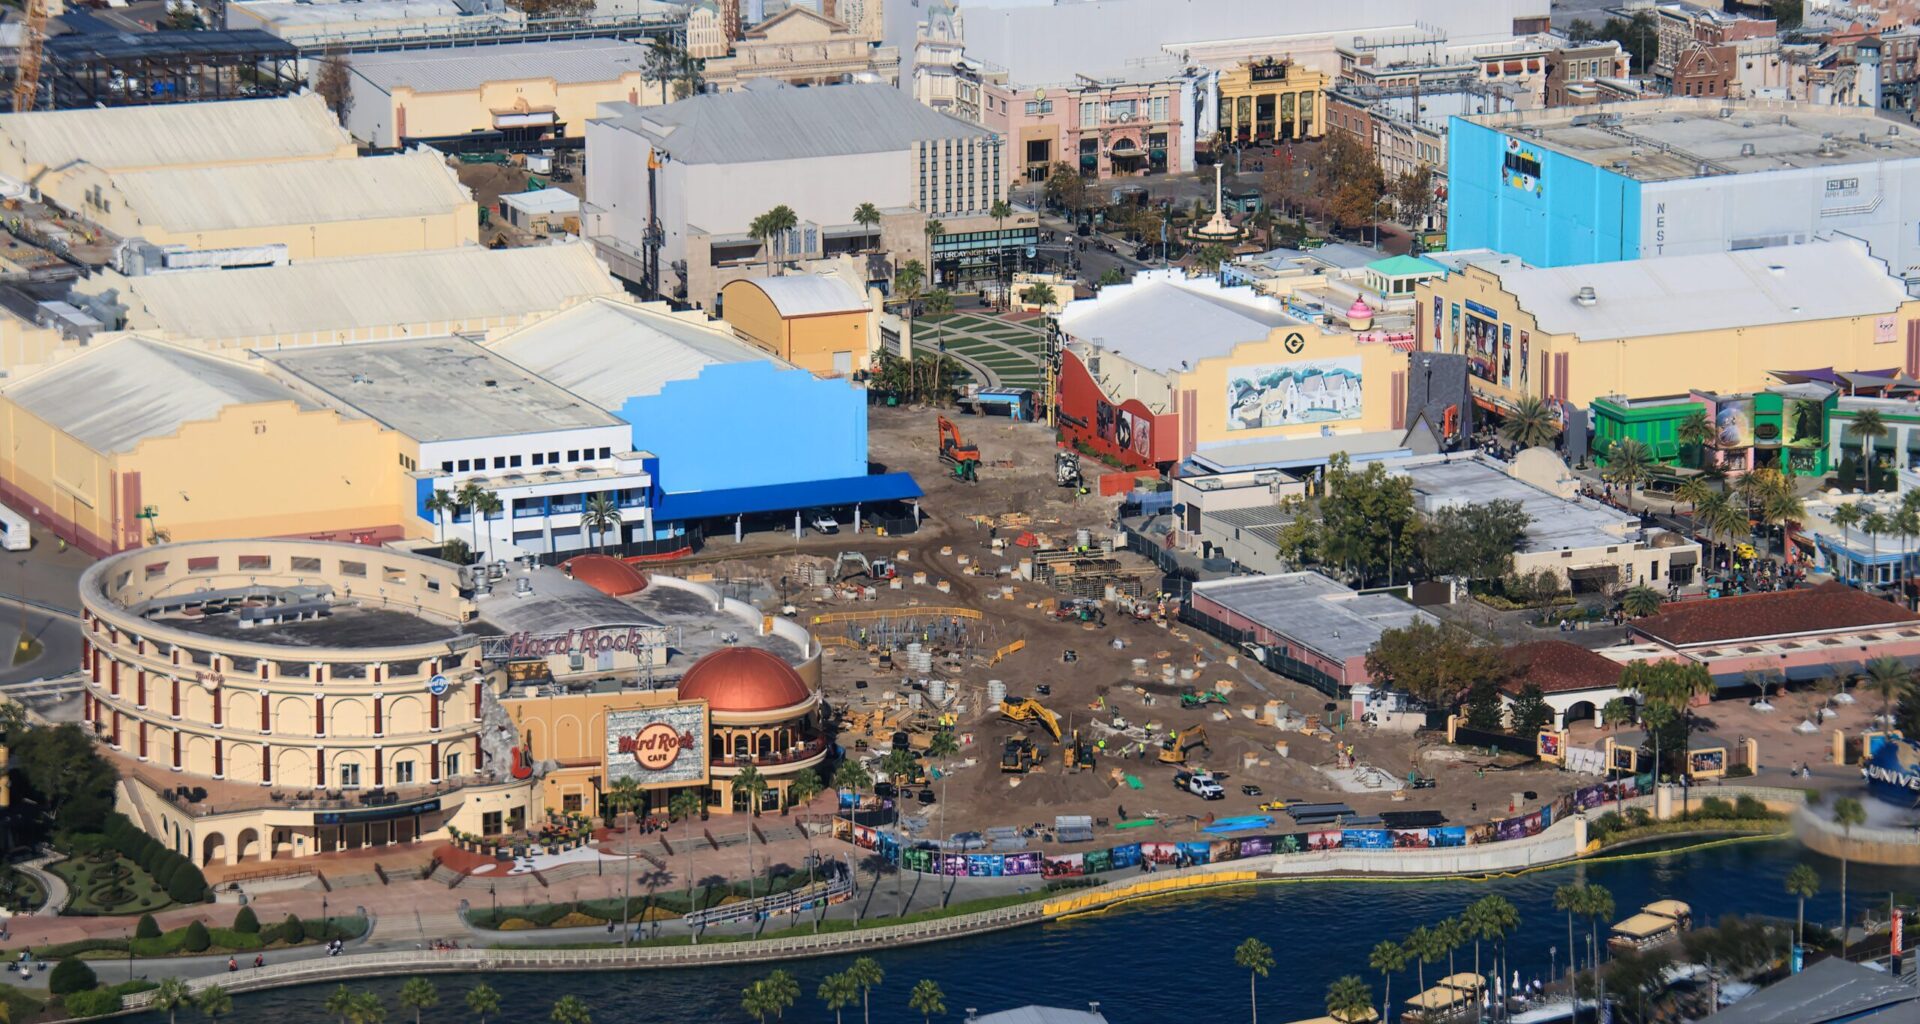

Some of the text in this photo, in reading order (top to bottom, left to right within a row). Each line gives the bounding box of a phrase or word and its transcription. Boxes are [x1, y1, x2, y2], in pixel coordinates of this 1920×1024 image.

[1656, 203, 1665, 255] NEST
[931, 250, 967, 260] SATURDAY
[509, 626, 643, 660] Hard Rock
[618, 730, 695, 753] Hard Rock
[647, 753, 667, 762] CAFE
